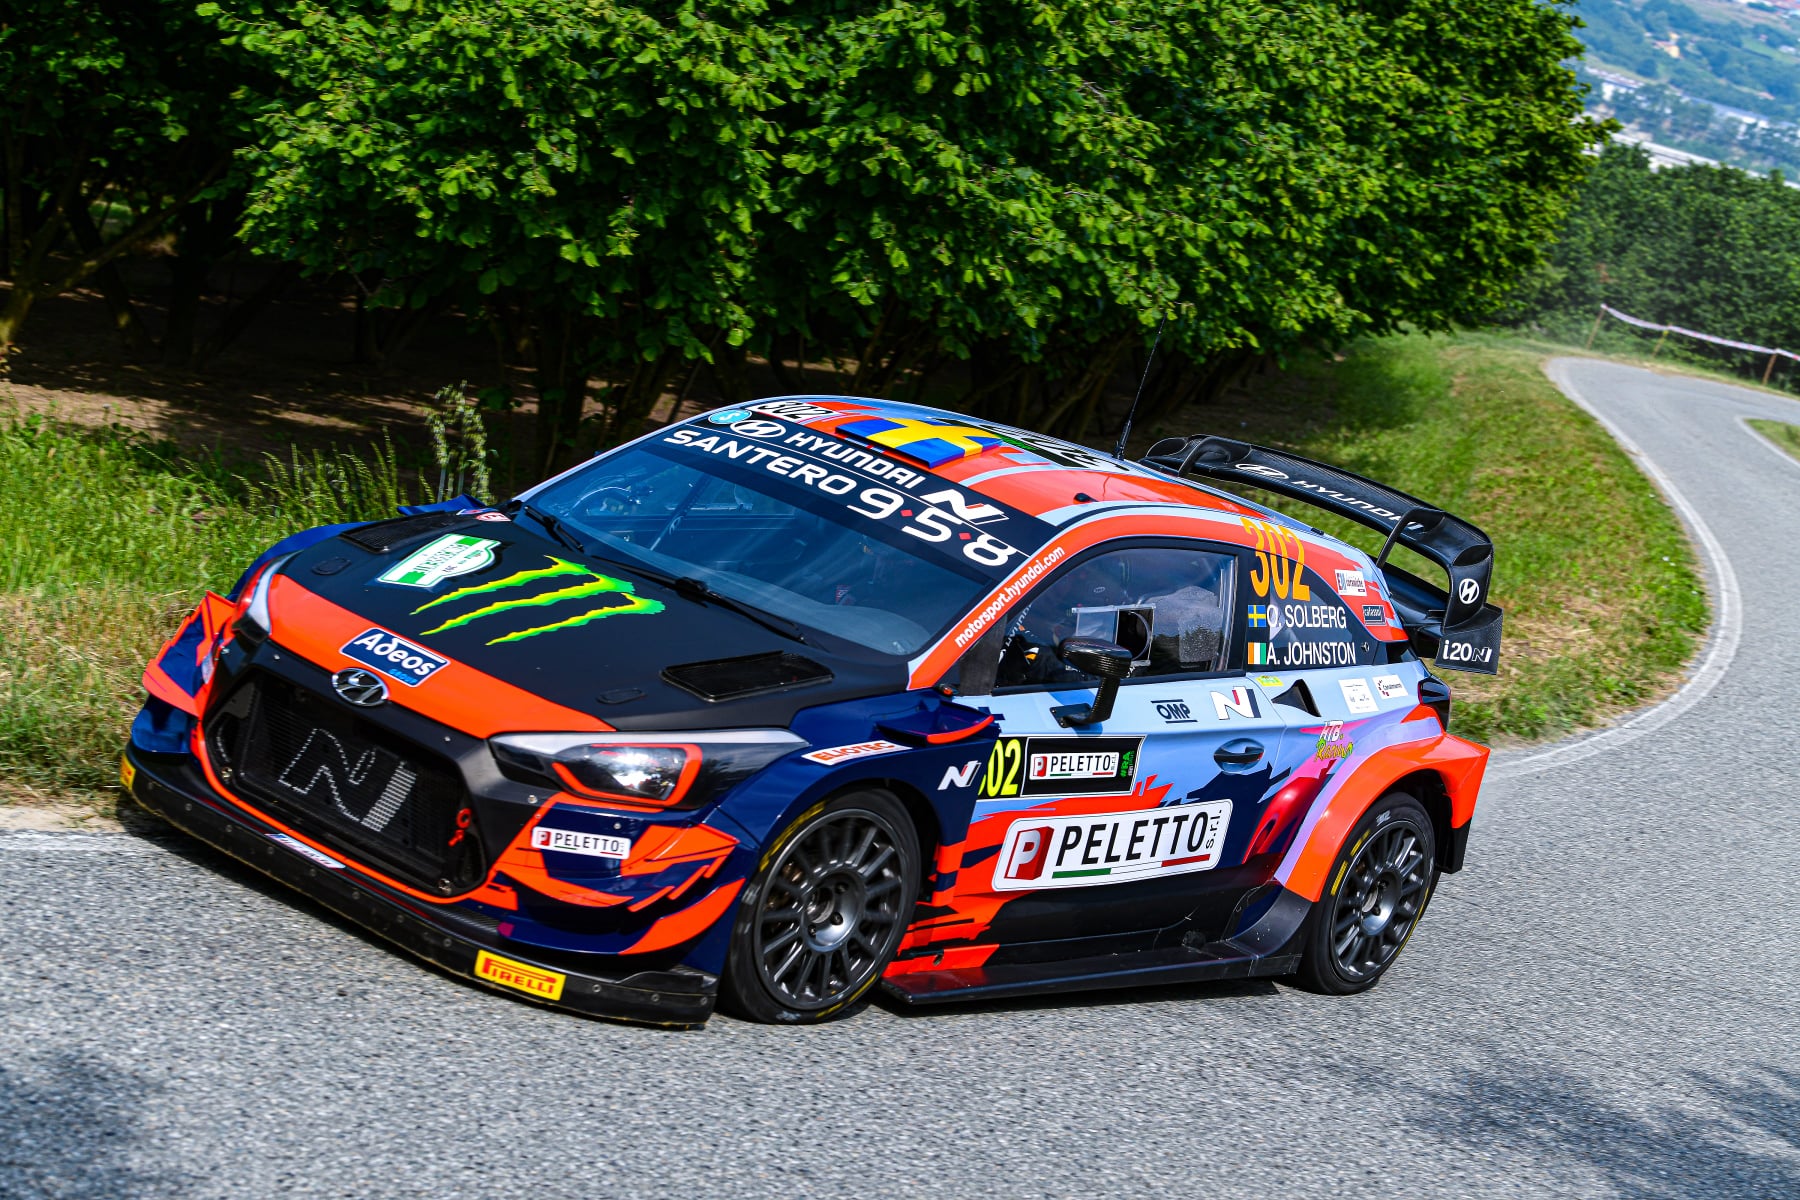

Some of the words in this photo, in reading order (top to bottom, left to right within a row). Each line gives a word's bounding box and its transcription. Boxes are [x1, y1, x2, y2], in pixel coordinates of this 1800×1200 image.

[757, 401, 834, 420] 302
[664, 429, 858, 495] SANTERO
[784, 431, 926, 489] HYUNDAI
[1241, 517, 1311, 602] 302
[954, 546, 1066, 648] motorsport.hyundai.com
[1285, 604, 1347, 629] SOLBERG
[353, 633, 437, 676] Adeos
[1266, 642, 1281, 665] A.
[1284, 641, 1357, 666] JOHNSTON
[1156, 703, 1191, 720] OMP
[811, 742, 895, 761] ELIOTEC
[977, 738, 1022, 797] 02
[1050, 755, 1111, 773] PELETTO
[554, 832, 620, 852] PELETTO
[1055, 811, 1208, 867] PELETTO
[482, 957, 557, 994] PIRELLI
